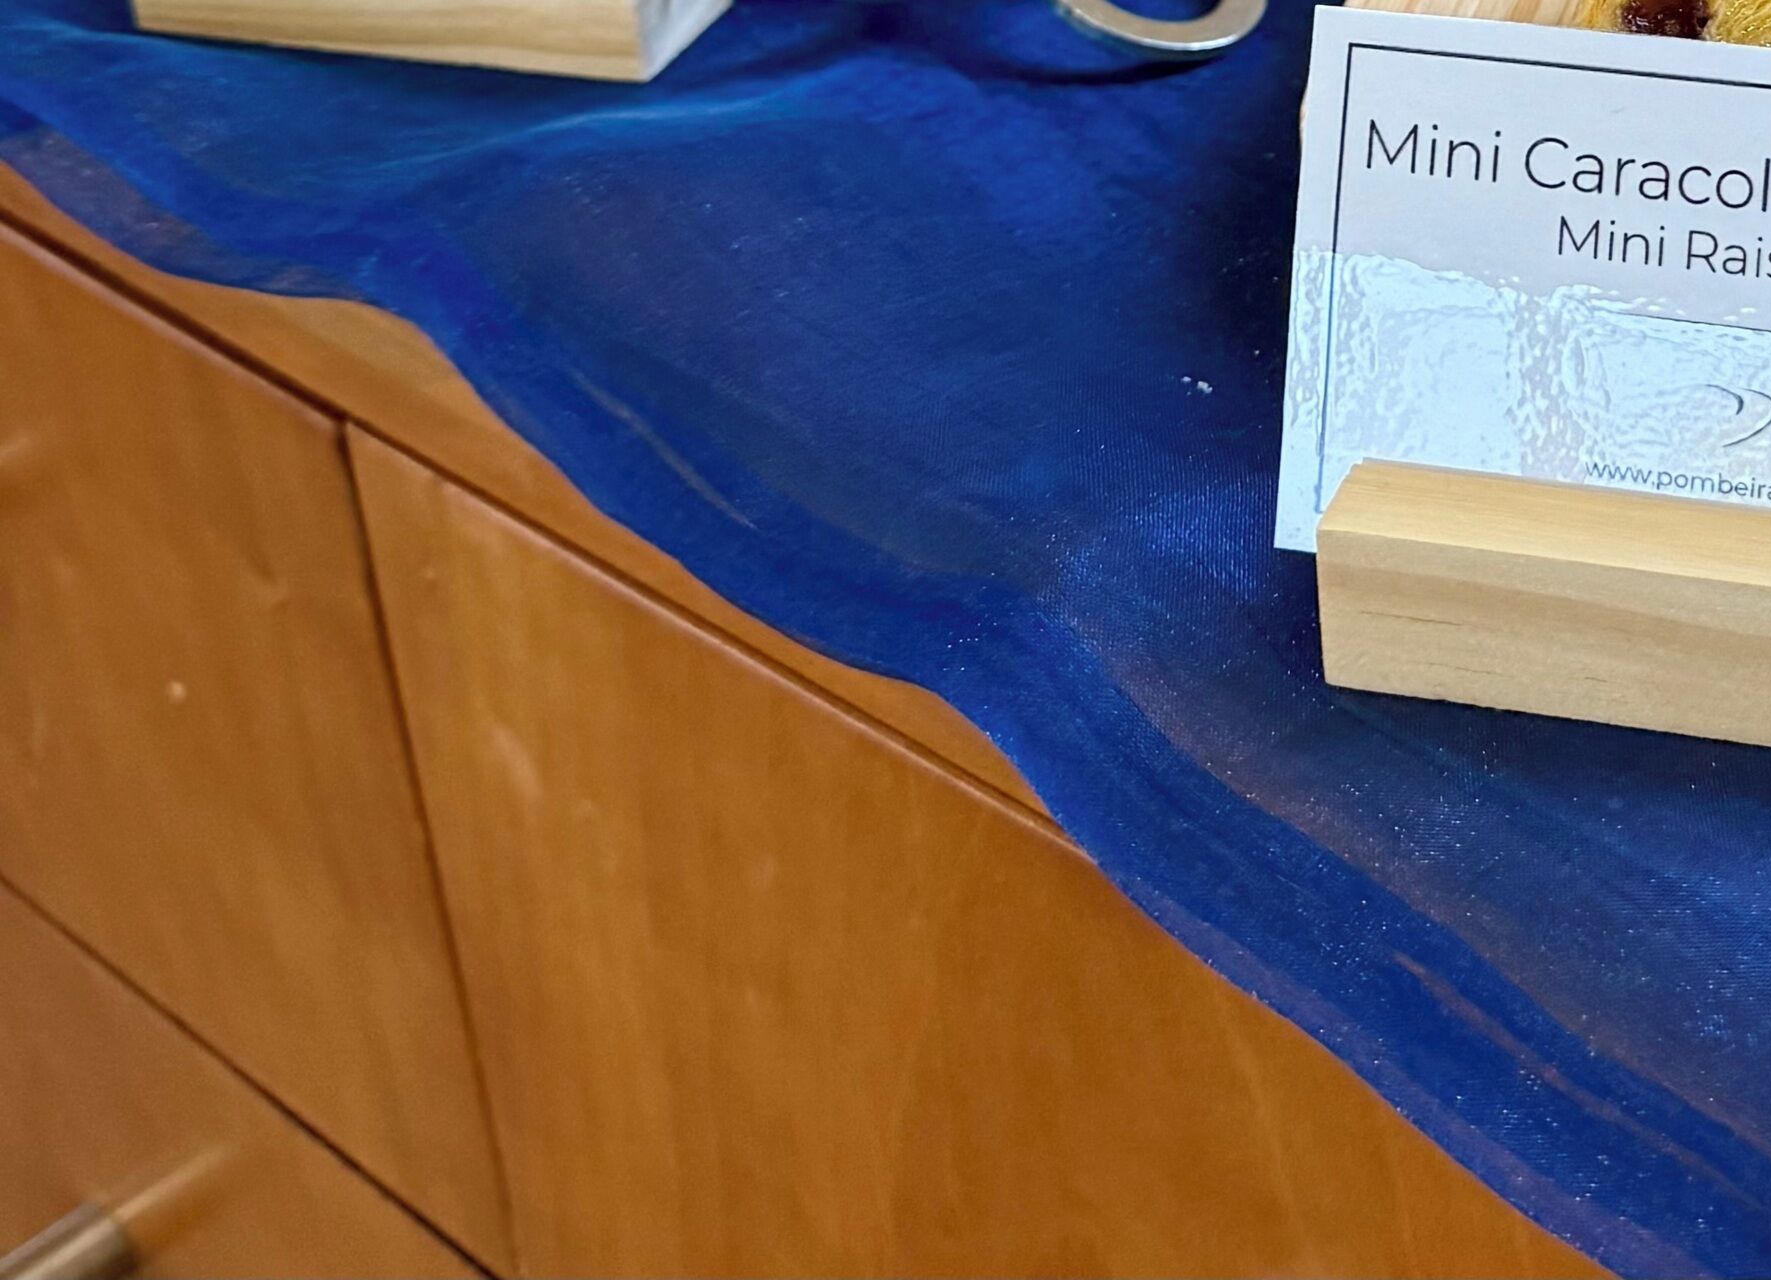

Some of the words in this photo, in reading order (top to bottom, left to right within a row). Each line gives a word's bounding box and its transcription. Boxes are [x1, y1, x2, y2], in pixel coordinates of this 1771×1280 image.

[1366, 118, 1502, 183] Mini
[1524, 136, 1771, 213] Caracol
[1557, 214, 1667, 267] Mini
